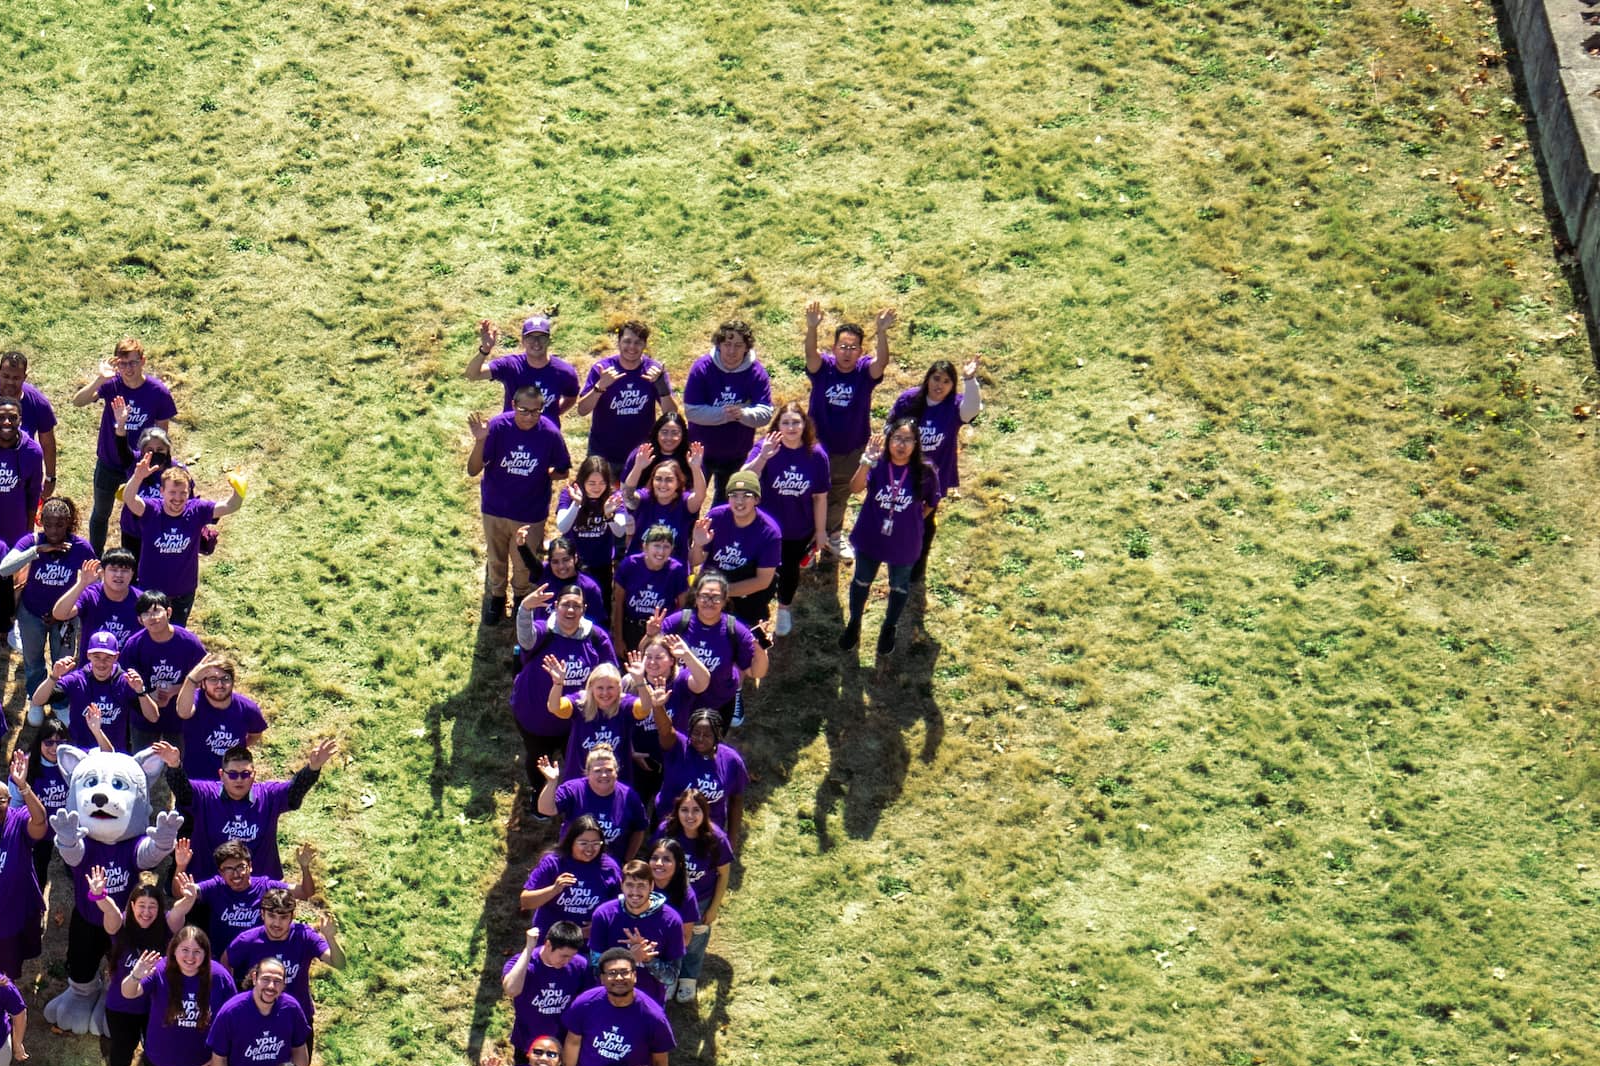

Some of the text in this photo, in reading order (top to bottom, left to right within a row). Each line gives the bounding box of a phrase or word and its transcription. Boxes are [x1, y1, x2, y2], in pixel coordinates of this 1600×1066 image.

[619, 389, 639, 398] YOU
[610, 393, 647, 409] belong
[616, 407, 639, 416] HERE
[510, 451, 530, 460] YOU
[501, 455, 538, 468] belong
[507, 466, 530, 476] HERE
[784, 471, 803, 480] YOU
[772, 476, 810, 491] belong
[154, 537, 191, 551] belong
[639, 591, 658, 599] YOU
[106, 622, 124, 631] YOU
[214, 731, 233, 739] YOU
[595, 732, 612, 740] YOU
[697, 779, 717, 789] YOU
[44, 785, 65, 794] YOU
[570, 888, 590, 896] YOU
[557, 891, 599, 907] belong
[564, 906, 587, 914] HERE
[220, 909, 261, 924] belong
[540, 989, 562, 997] YOU
[532, 993, 571, 1011] belong
[538, 1006, 561, 1015] HERE
[256, 1036, 277, 1046] YOU
[602, 1032, 624, 1042] YOU
[245, 1041, 285, 1057] belong
[593, 1037, 631, 1056] belong
[252, 1051, 278, 1061] HERE
[598, 1049, 621, 1060] HERE
